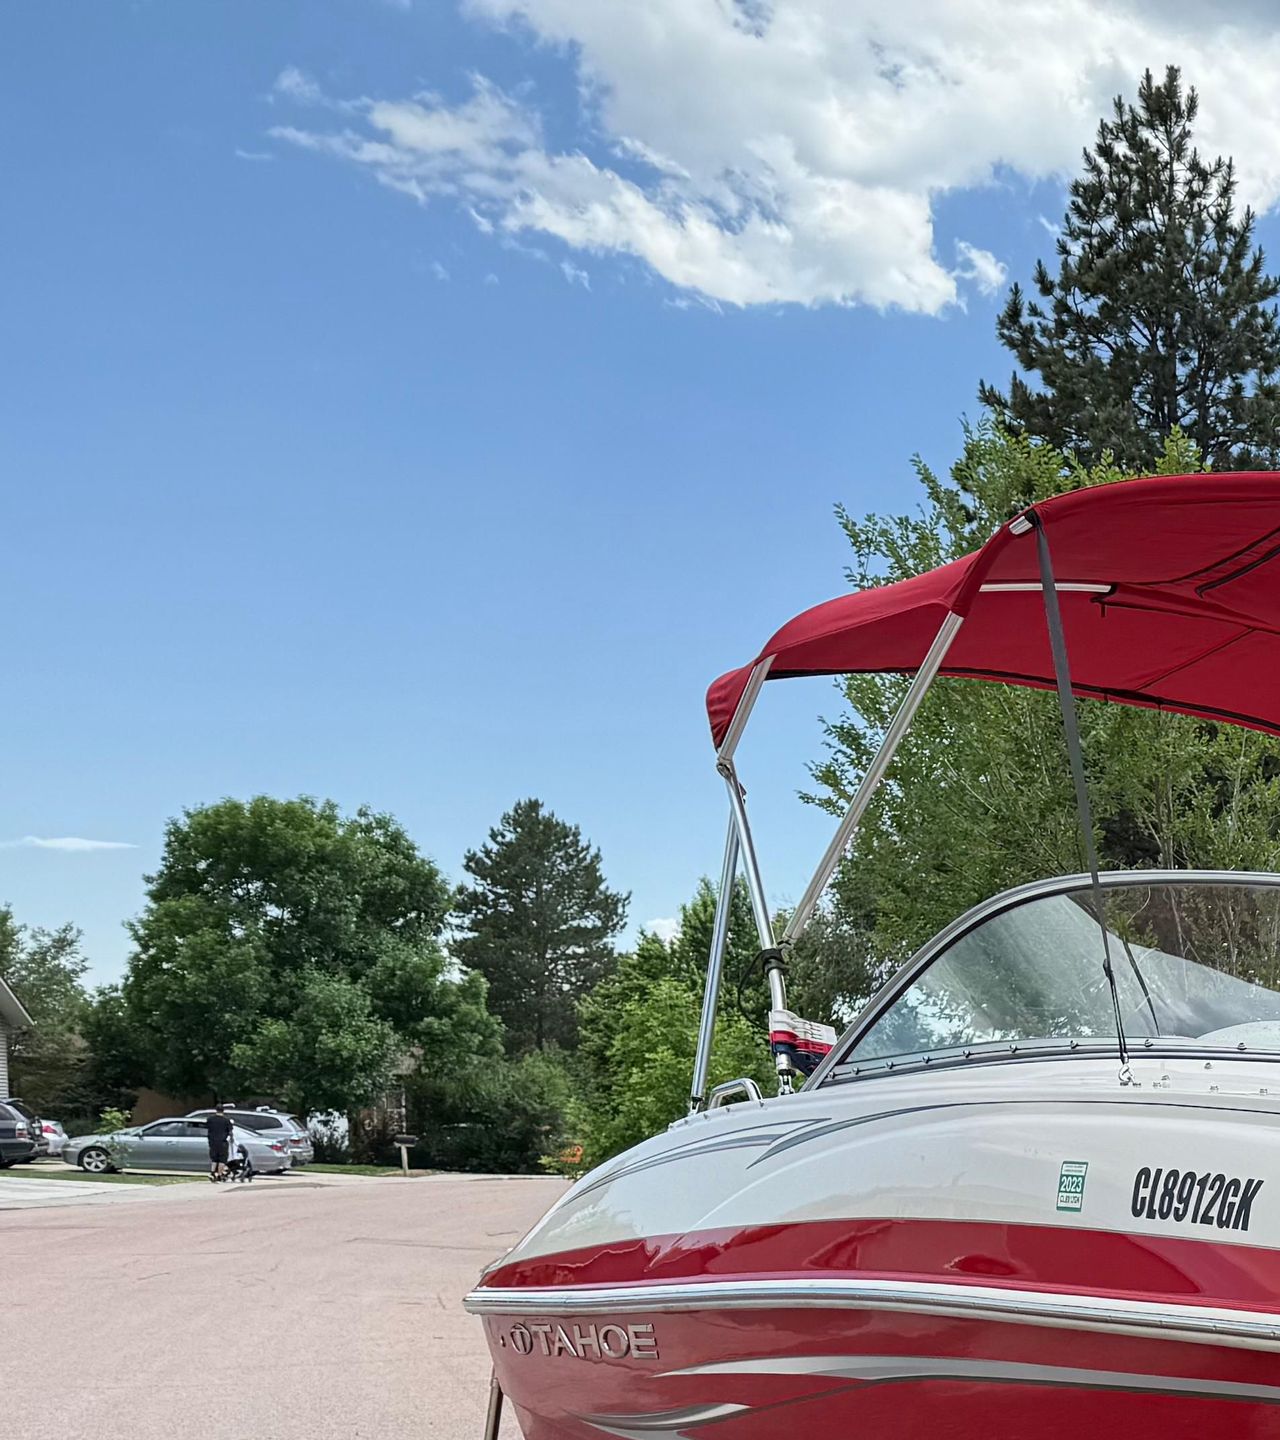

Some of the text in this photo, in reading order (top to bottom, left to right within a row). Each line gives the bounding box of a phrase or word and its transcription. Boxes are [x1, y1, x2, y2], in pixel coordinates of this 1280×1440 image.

[1060, 1176, 1083, 1192] 2023
[1131, 1166, 1265, 1231] CL8912GK
[530, 1323, 659, 1360] TAHOE
